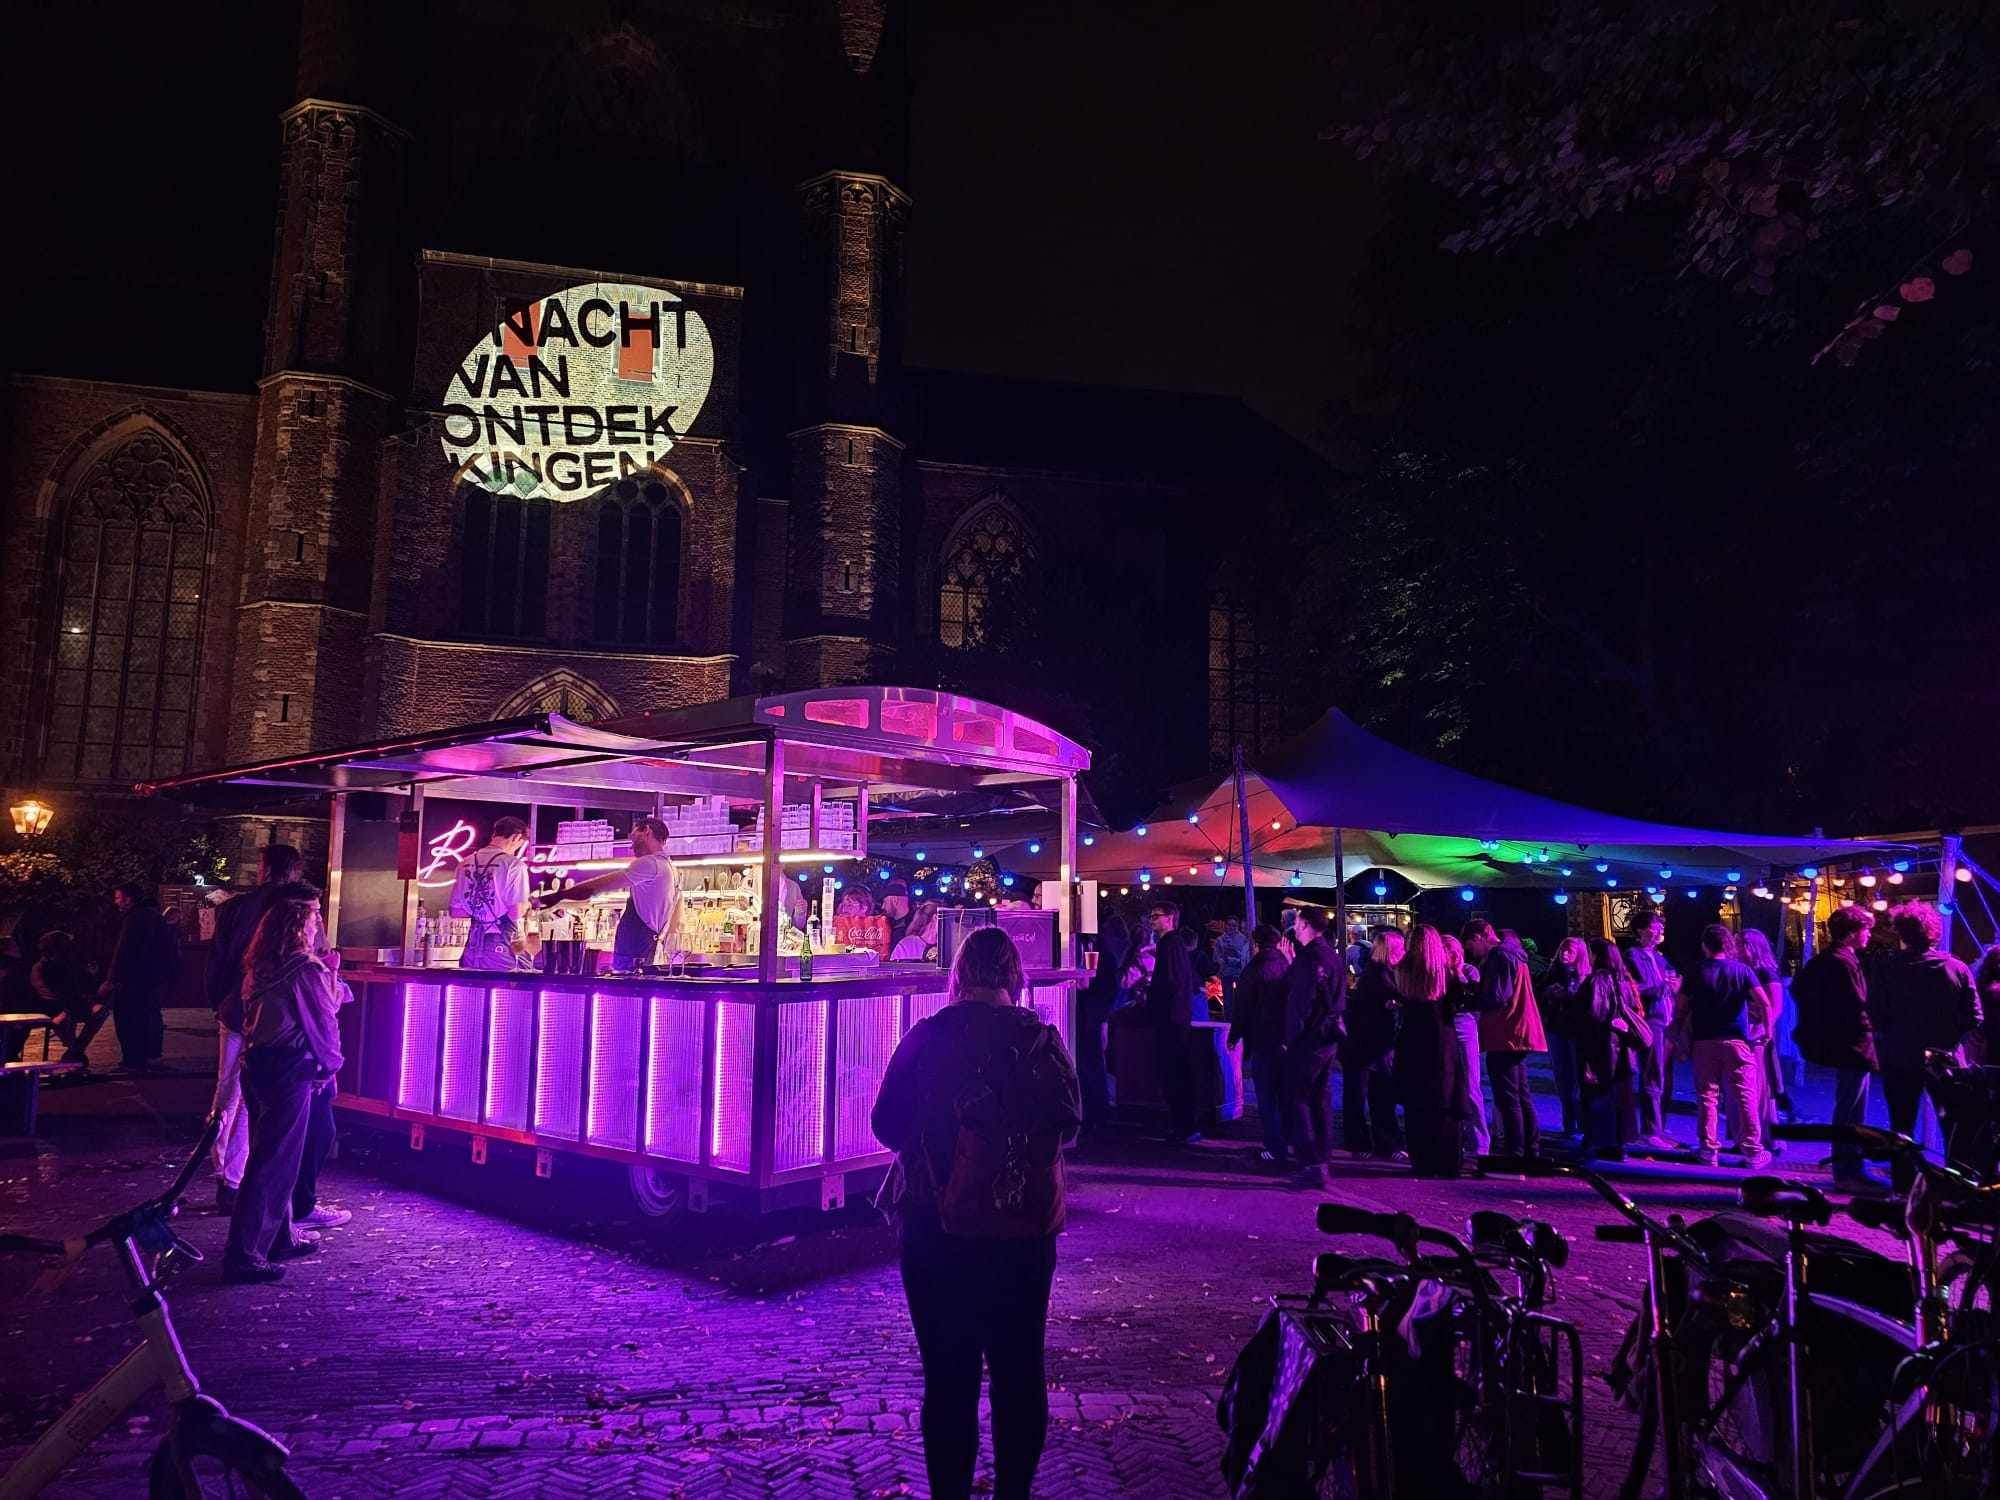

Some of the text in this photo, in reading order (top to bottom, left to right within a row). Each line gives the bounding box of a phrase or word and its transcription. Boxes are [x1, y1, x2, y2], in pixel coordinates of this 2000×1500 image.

[493, 297, 691, 348] NACHT
[456, 354, 571, 398] VAN
[441, 403, 682, 446] ONTDEK
